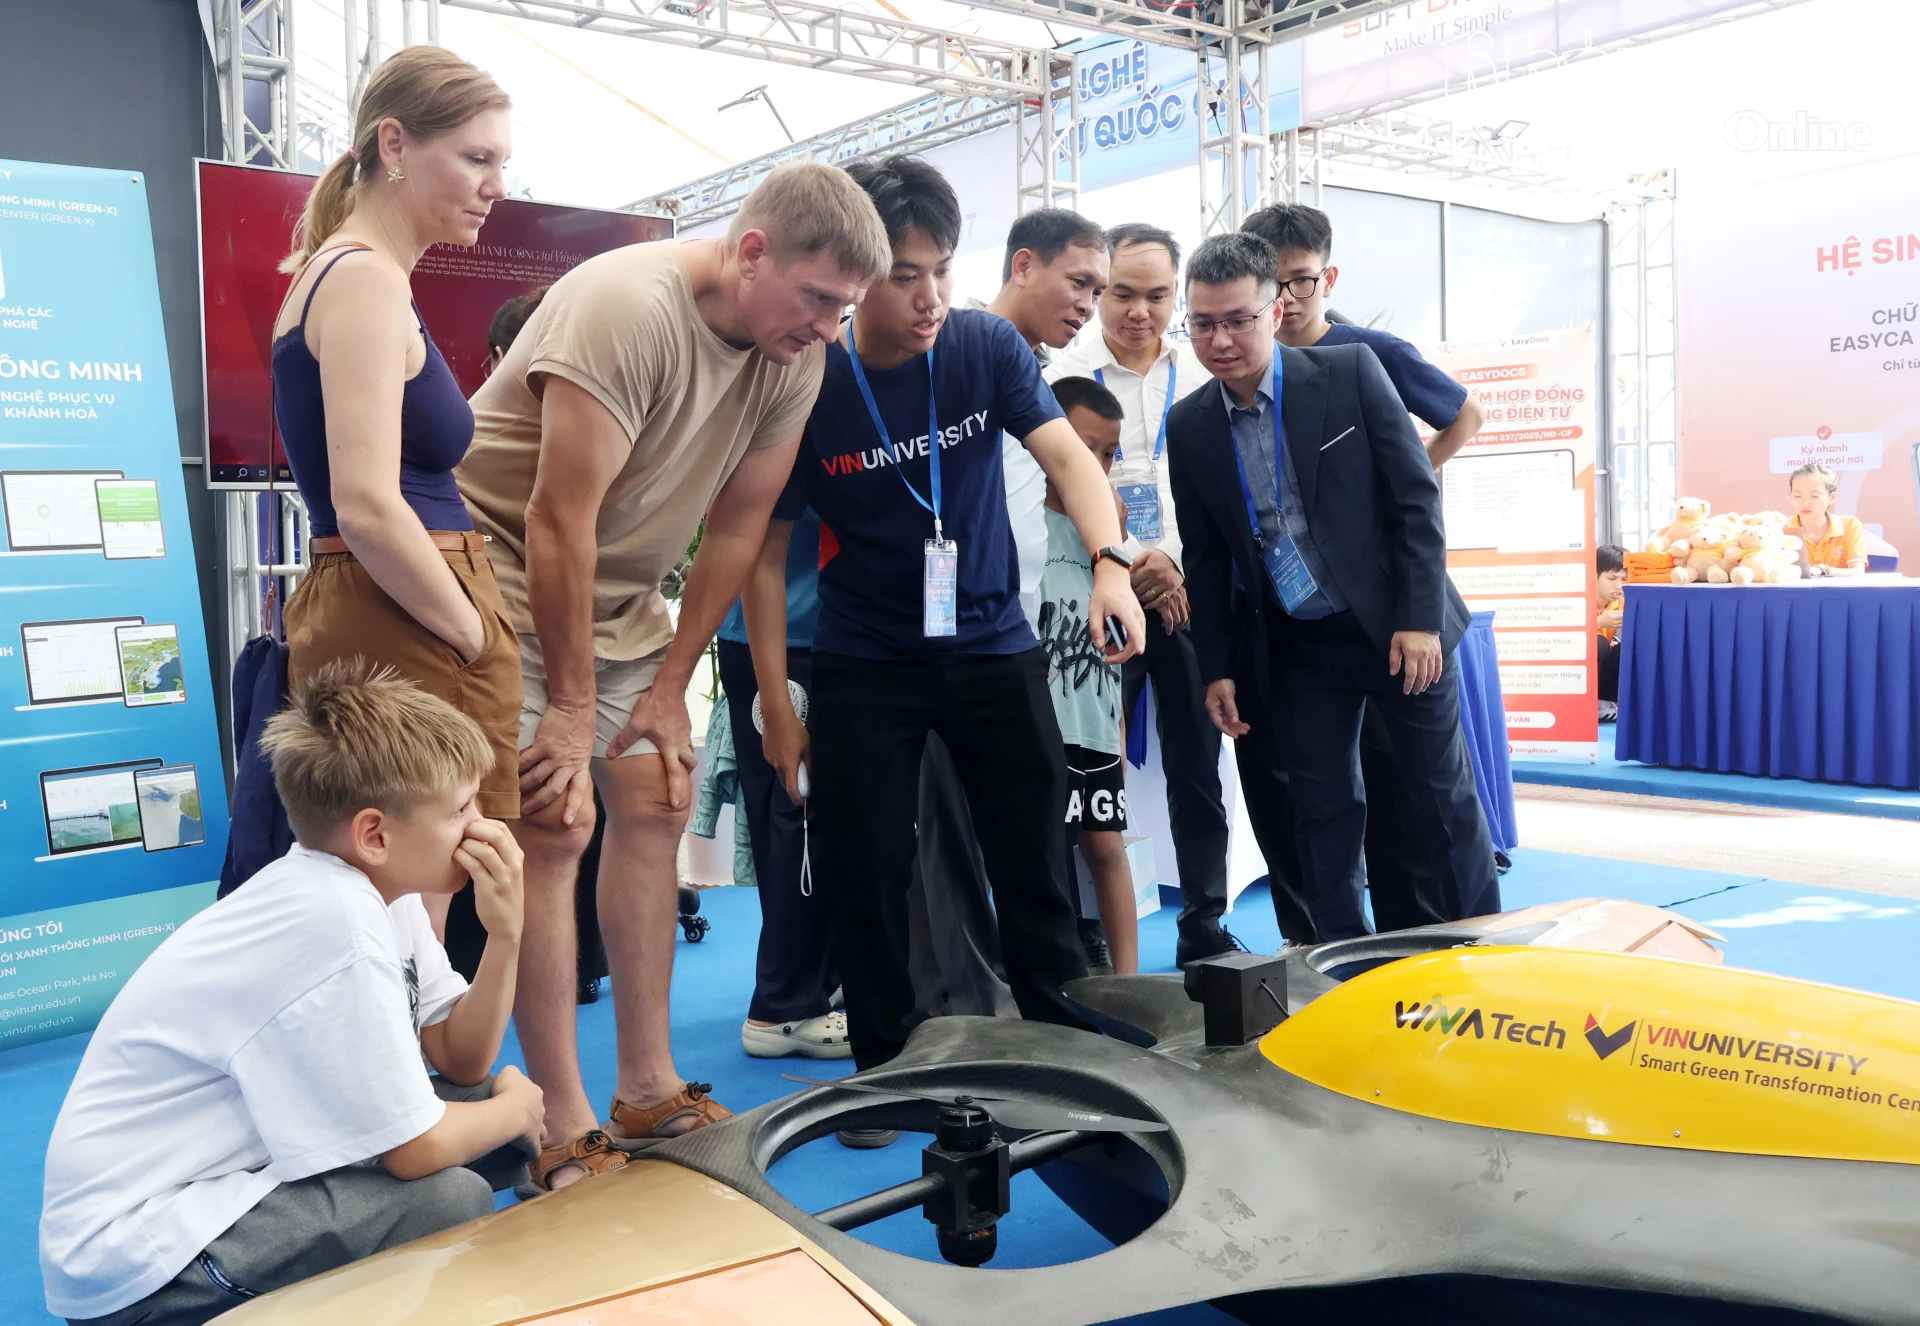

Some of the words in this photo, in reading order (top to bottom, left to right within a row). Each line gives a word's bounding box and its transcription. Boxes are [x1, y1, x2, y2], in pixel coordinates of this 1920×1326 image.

[1384, 31, 1427, 55] Make
[1433, 22, 1448, 41] IT
[1454, 5, 1512, 36] Simple
[1095, 84, 1183, 149] QUỐC
[0, 194, 20, 205] NG
[23, 197, 56, 209] MINH
[58, 200, 118, 217] (GREEN-X)
[41, 212, 95, 228] (GREEN-X)
[1817, 235, 1862, 277] HỆ
[27, 306, 53, 318] CÁC
[1872, 302, 1919, 325] CHỮ
[3, 318, 39, 332] NGHỆ
[1511, 335, 1550, 347] EasyDocs
[1830, 330, 1914, 353] EASYCA
[0, 353, 61, 380] ÔNG
[69, 360, 143, 382] MINH
[1461, 367, 1527, 382] EASYDOCS
[1883, 358, 1905, 371] Chỉ
[0, 389, 45, 406] NGHỆ
[48, 392, 91, 406] PHỤC
[94, 393, 116, 407] VỤ
[1496, 388, 1532, 406] HỢP
[1535, 383, 1585, 402] ĐỒNG
[4, 405, 61, 419] KHÁNH
[65, 406, 99, 420] HOÀ
[1507, 404, 1545, 424] ĐIỆN
[1549, 402, 1573, 419] TỬ
[822, 409, 989, 476] VINUNIVERSITY
[1499, 429, 1574, 442] 337/2025/NĐ-CP
[1816, 443, 1848, 453] nhanh
[1826, 455, 1845, 467] mọi
[1848, 454, 1864, 464] nơi
[1515, 747, 1558, 755] easydocs.vn
[35, 920, 63, 937] TÔI
[16, 946, 48, 961] XANH
[50, 938, 90, 954] THÔNG
[92, 932, 121, 947] MINH
[123, 921, 175, 942] (GREEN-X)
[17, 984, 51, 998] Ocean
[54, 976, 81, 991] Park,
[82, 974, 97, 985] Ha
[99, 969, 117, 981] Noi
[1491, 1012, 1567, 1049] Tech
[1647, 1024, 1869, 1076] VINUNIVERSITY
[1639, 1053, 1687, 1074] Smart
[1690, 1061, 1740, 1082] Green
[1744, 1069, 1883, 1105] Transformation
